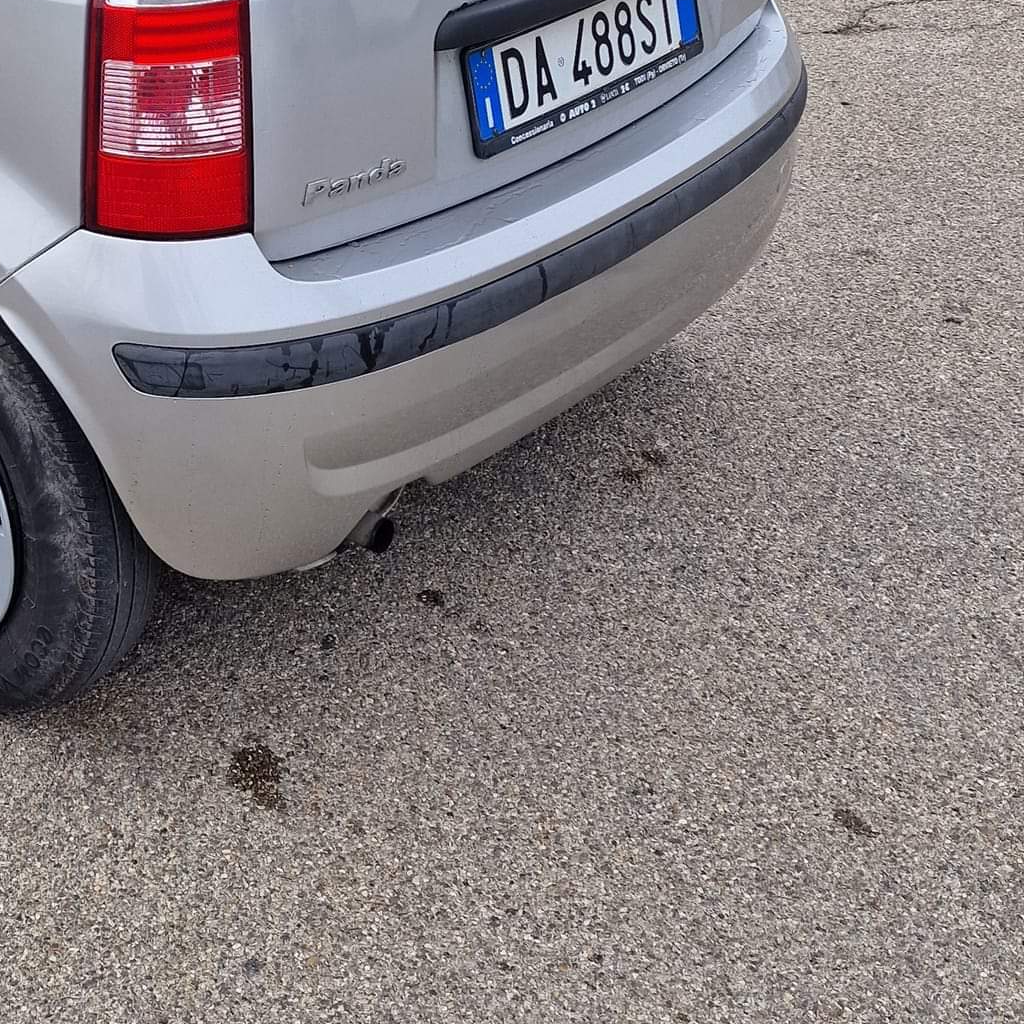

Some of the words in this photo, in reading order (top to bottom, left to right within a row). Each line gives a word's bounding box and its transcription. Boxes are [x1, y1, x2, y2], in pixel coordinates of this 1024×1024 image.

[500, 36, 558, 119] DA
[568, 102, 590, 119] AUTO
[302, 157, 407, 207] Panda
